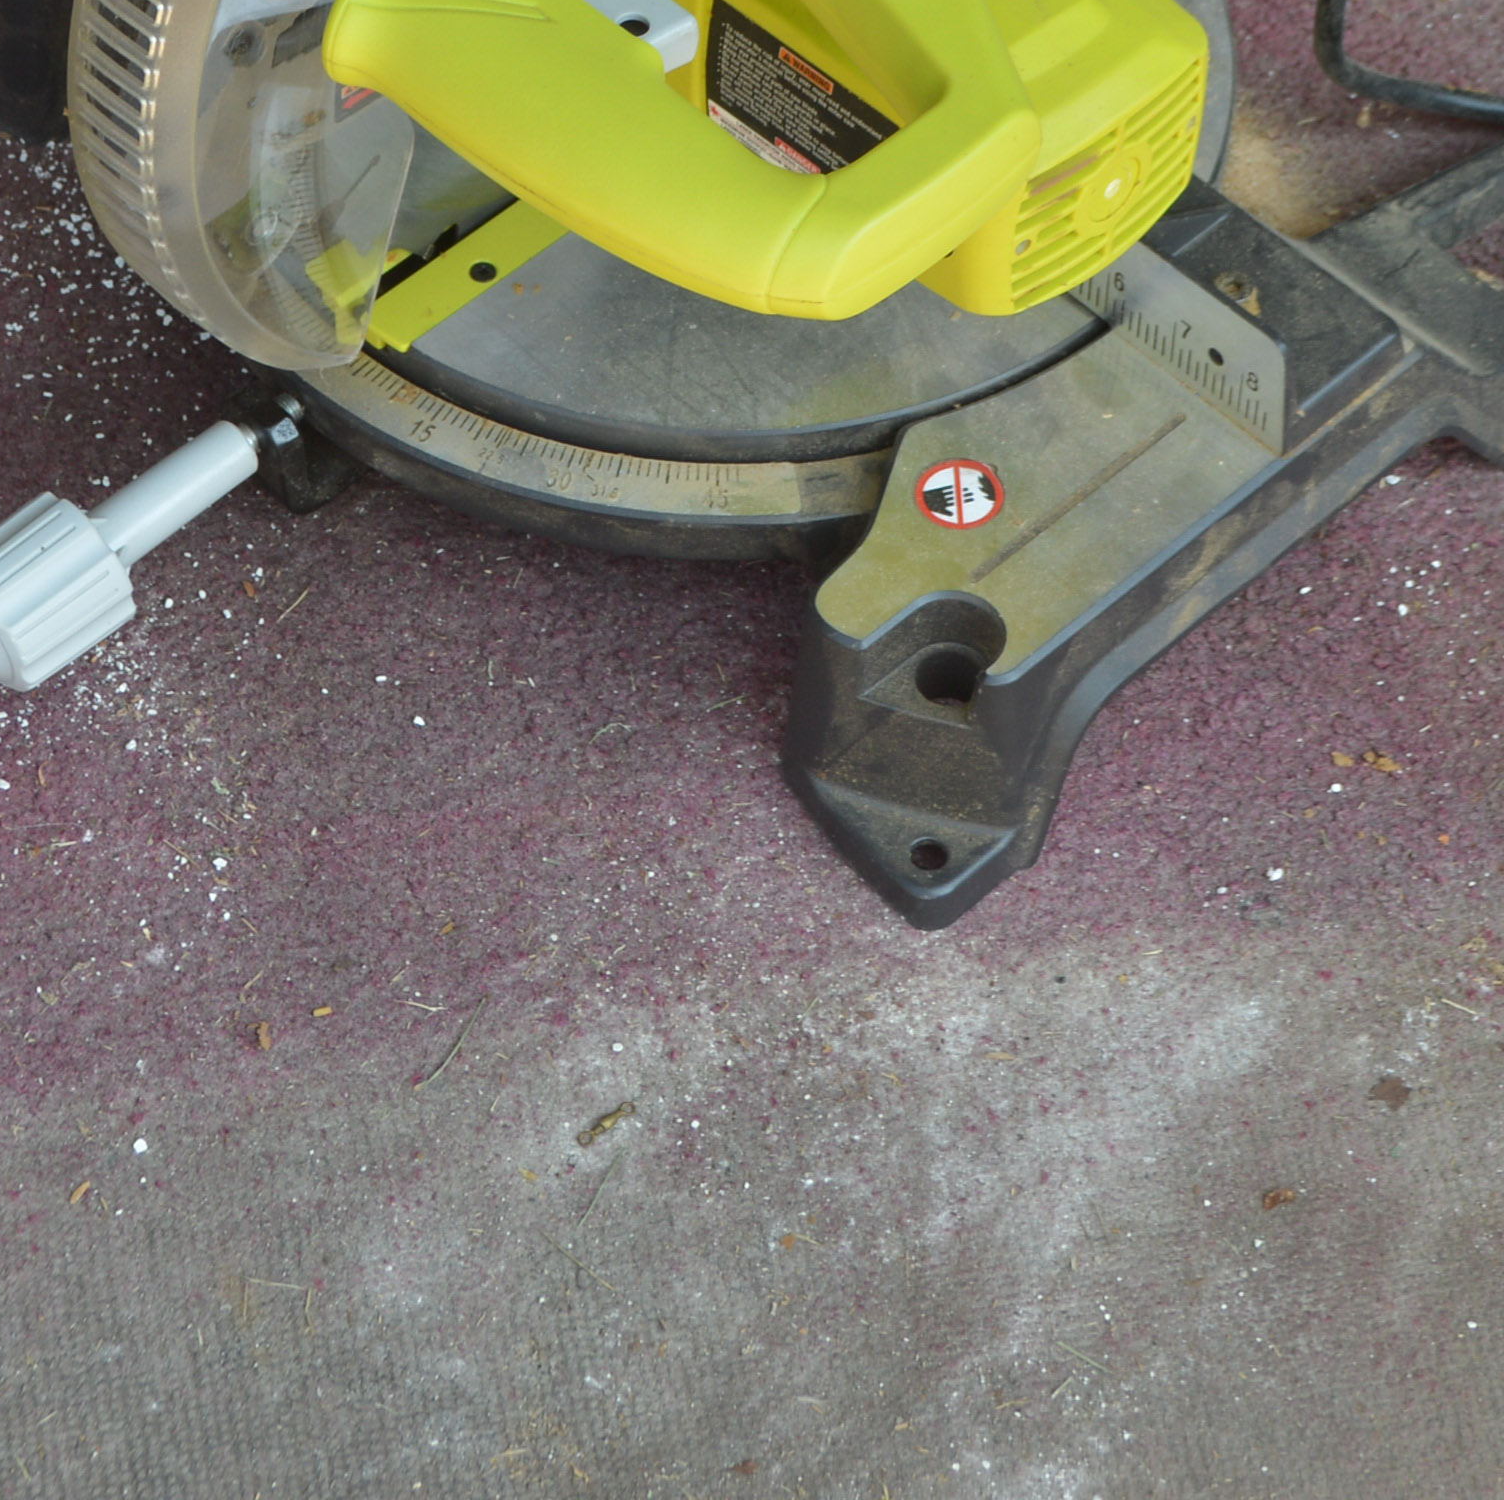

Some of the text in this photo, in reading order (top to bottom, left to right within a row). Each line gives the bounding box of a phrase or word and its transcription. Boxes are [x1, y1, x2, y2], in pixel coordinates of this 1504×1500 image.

[793, 57, 830, 92] WARNING
[1114, 272, 1125, 292] 6
[1181, 320, 1192, 339] 7
[1247, 371, 1259, 392] 8
[408, 420, 437, 443] 15
[547, 467, 573, 491] 30
